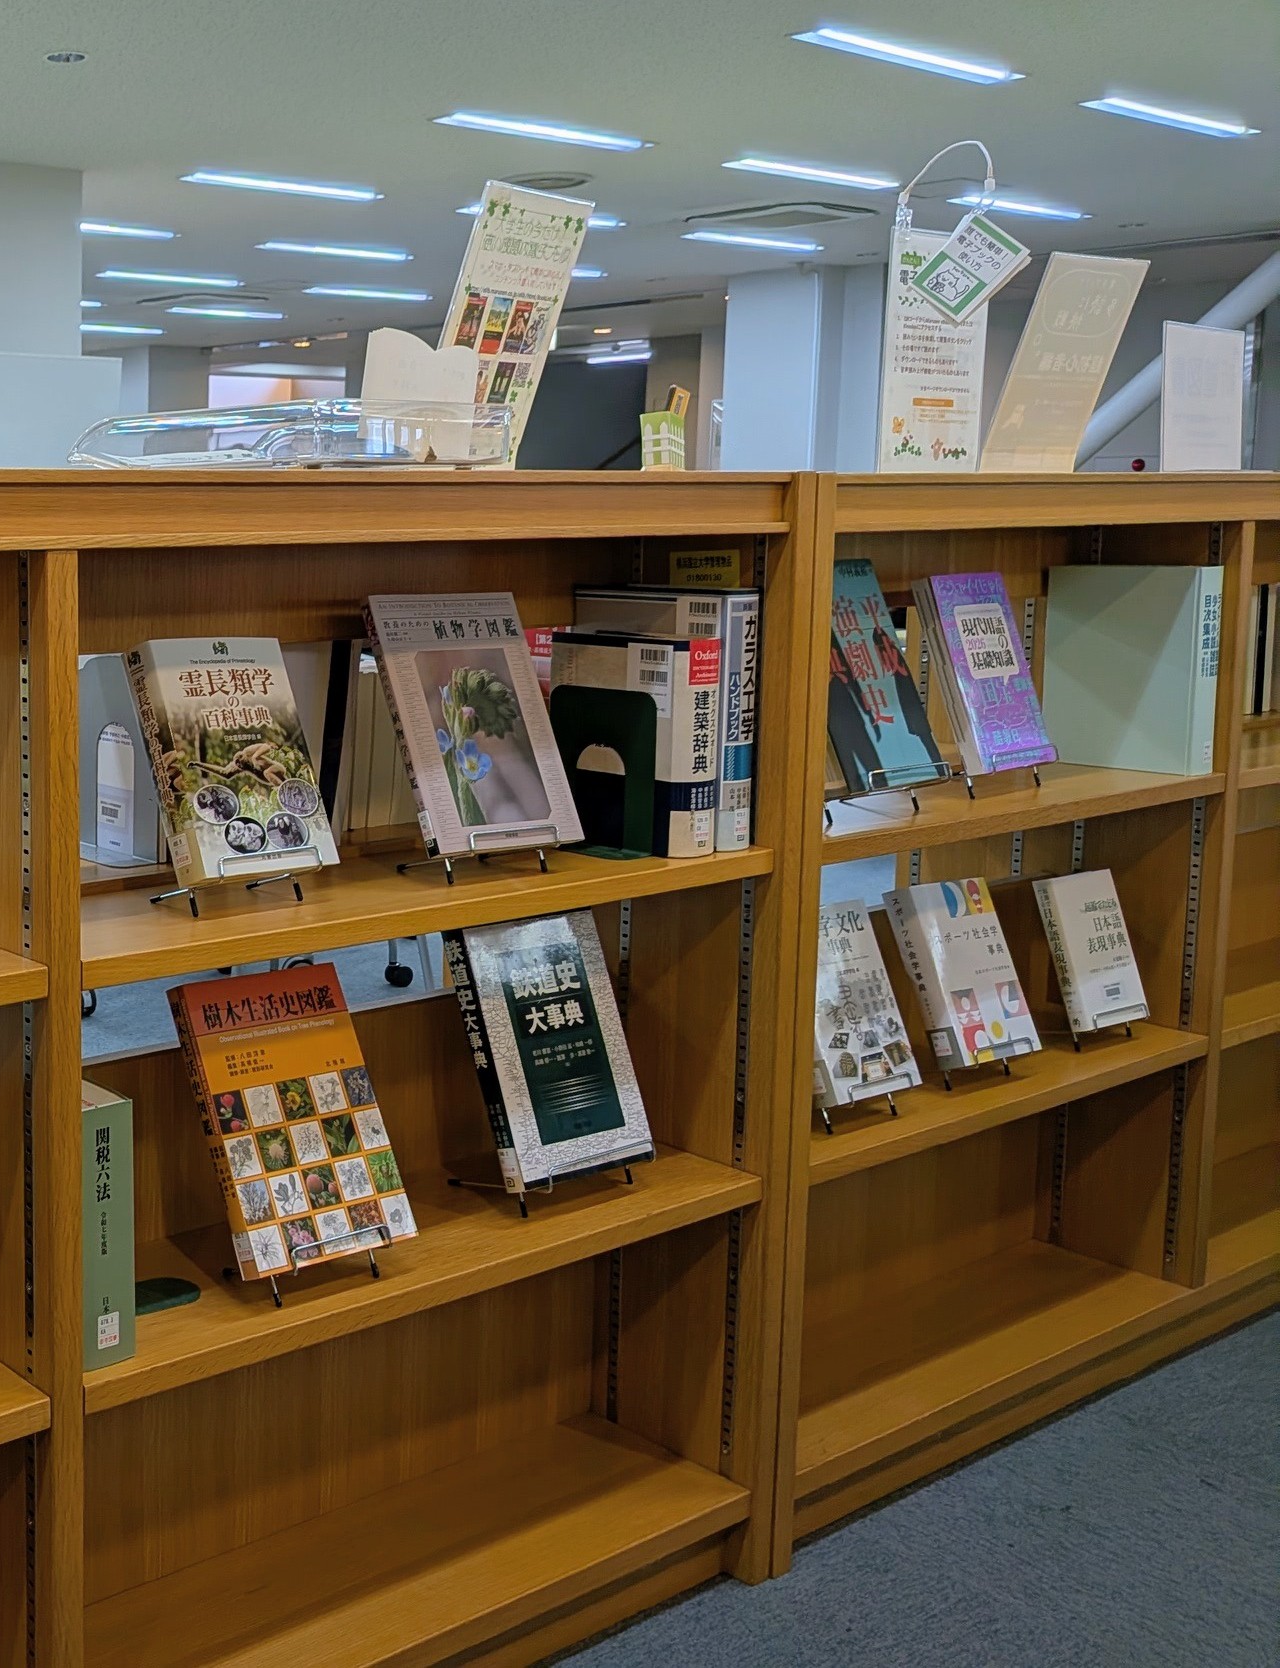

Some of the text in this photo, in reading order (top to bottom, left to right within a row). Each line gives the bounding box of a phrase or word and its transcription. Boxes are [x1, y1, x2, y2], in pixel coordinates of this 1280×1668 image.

[956, 234, 1002, 271] 電子ブックの
[957, 251, 983, 272] 使い方
[432, 617, 520, 640] 植物学図鑑
[960, 616, 1006, 638] 現代用語
[1201, 594, 1213, 651] 目次集成
[966, 636, 987, 651] 2026
[997, 634, 1010, 650] の
[694, 650, 719, 661] Oxford
[970, 648, 1016, 671] 基礎知識
[178, 667, 275, 698] 霊長類学
[740, 615, 757, 741] ガラス工学
[227, 695, 240, 708] の
[727, 674, 741, 741] ハンドブック
[202, 706, 271, 729] 百科事典
[691, 691, 711, 775] 建築辞典
[1092, 911, 1123, 932] 日本語
[827, 937, 853, 956] 事典
[891, 897, 927, 993] スポーツ社会学事典
[987, 942, 1005, 957] 事典
[1086, 931, 1128, 955] 表現事典
[509, 960, 581, 1000] 鉄道史
[201, 984, 338, 1031] 樹木生活史図鑑
[443, 939, 488, 1070] 鉄道史大事典
[525, 999, 586, 1035] 大事典
[95, 1126, 111, 1203] 関税六法
